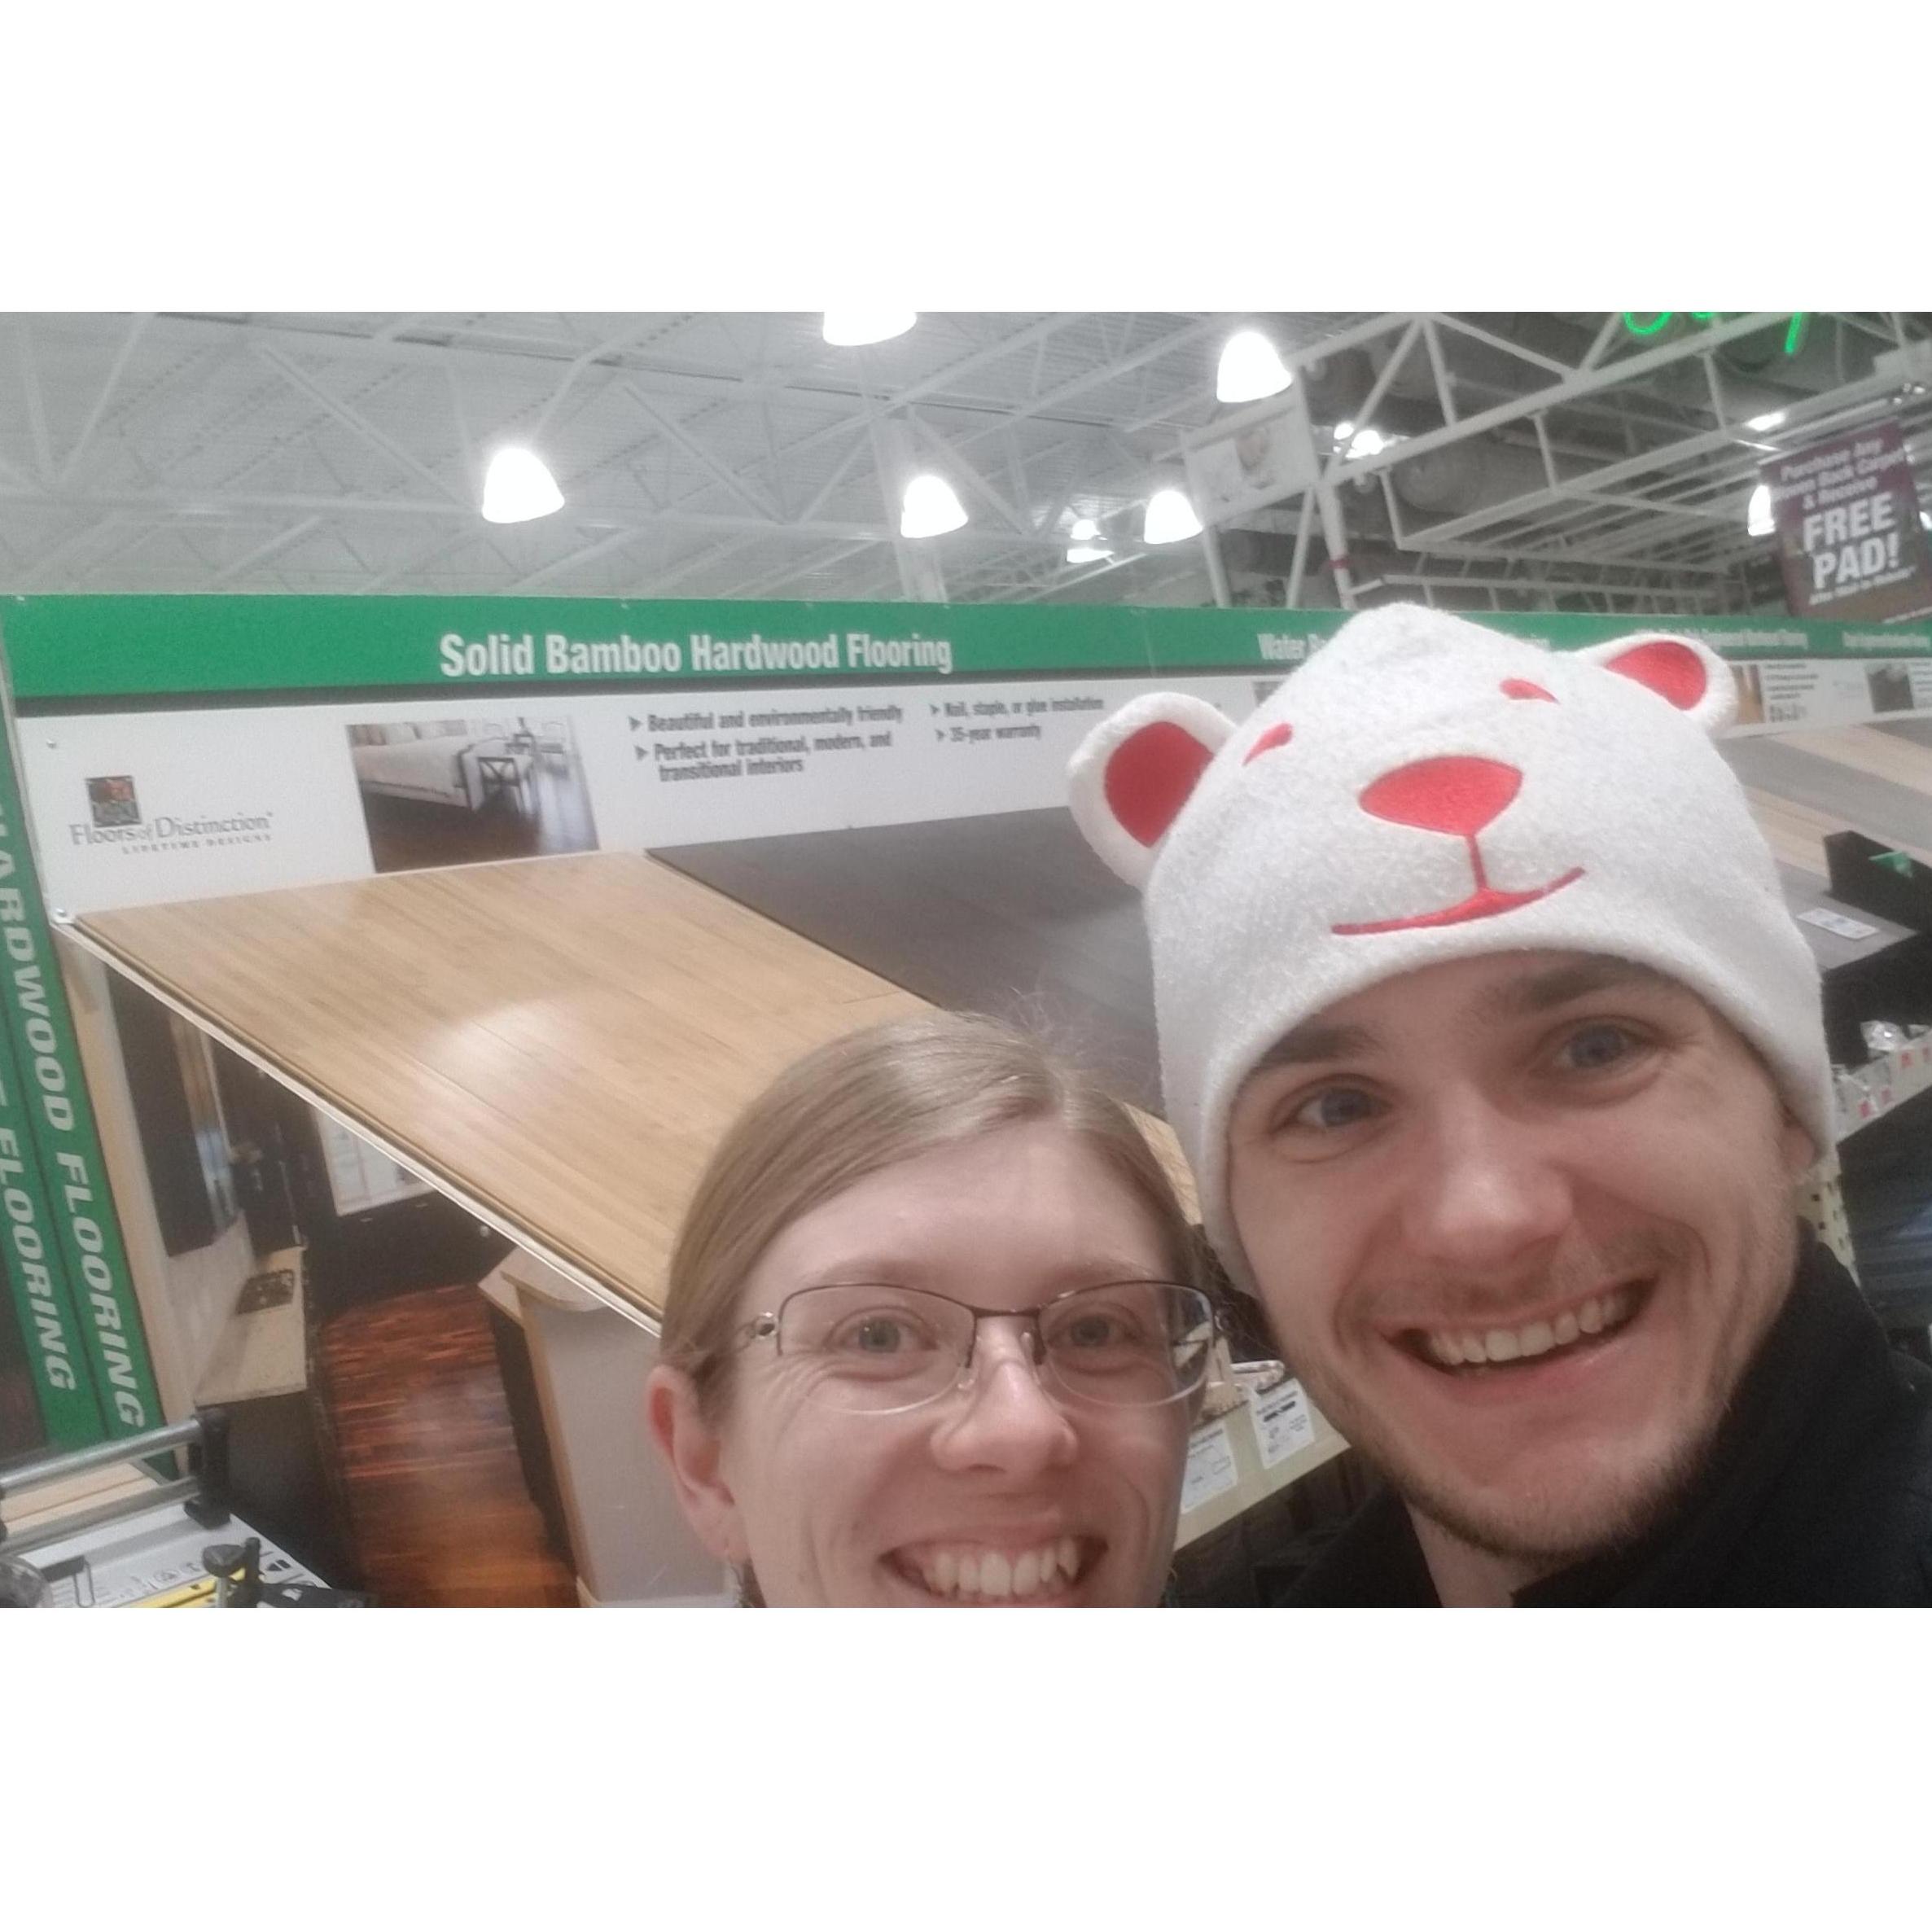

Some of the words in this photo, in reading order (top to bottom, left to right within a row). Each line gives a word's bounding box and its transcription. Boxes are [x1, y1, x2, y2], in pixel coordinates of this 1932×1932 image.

[1803, 491, 1897, 551] FREE
[1812, 532, 1900, 589] PAD!
[440, 633, 534, 677] Solid
[545, 633, 682, 675] Bamboo
[690, 633, 840, 672] Hardwood
[845, 633, 953, 675] Flooring
[647, 711, 715, 732] Beautiful
[718, 710, 745, 729] and
[748, 707, 854, 727] environmentally
[856, 703, 903, 725] friendly
[655, 740, 708, 761] Perfect
[711, 738, 732, 758] for
[869, 730, 892, 748] and
[659, 759, 743, 782] transitional
[745, 756, 804, 776] interiors
[68, 823, 135, 845] Floors
[0, 801, 75, 1132] ARDWOOD
[56, 1151, 146, 1429] FLOORING
[0, 1126, 77, 1392] FLOORING
